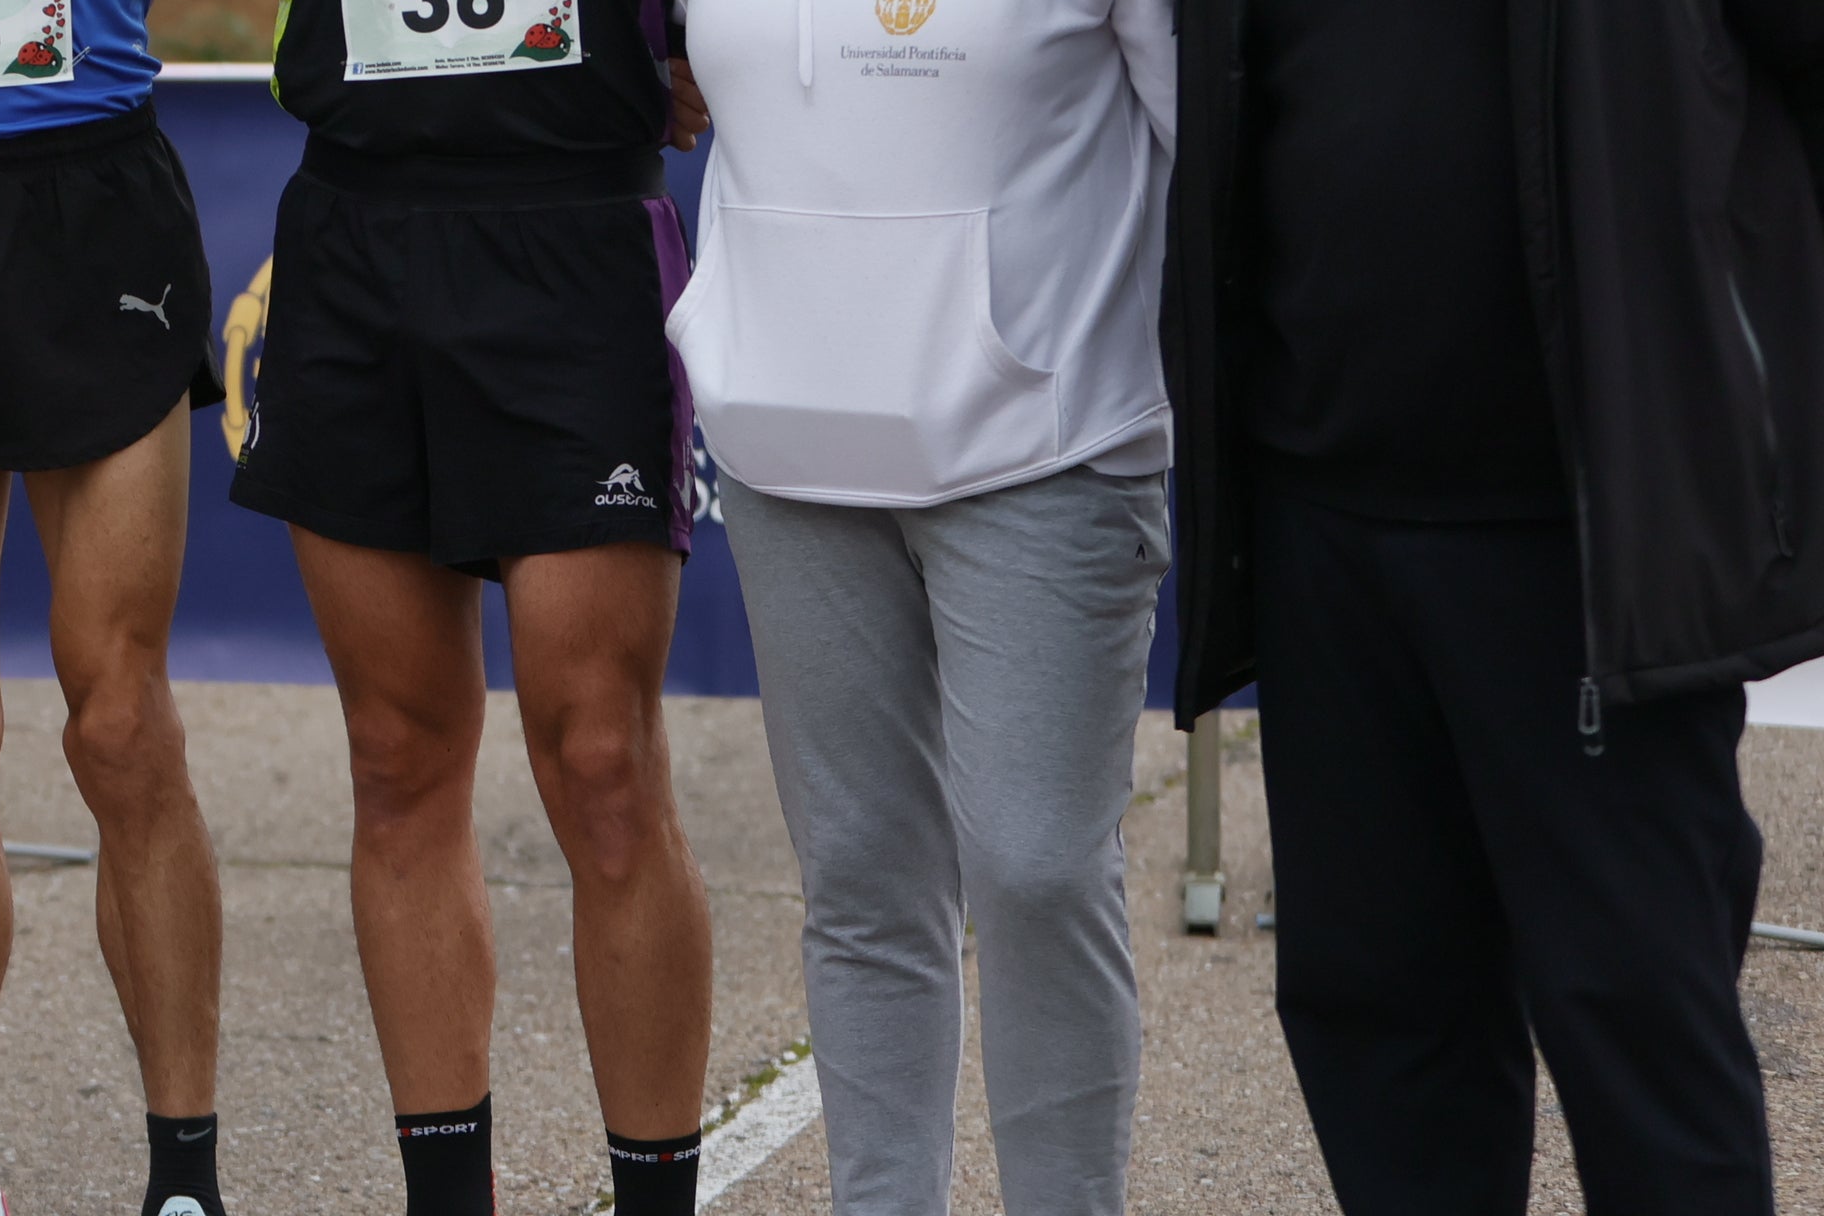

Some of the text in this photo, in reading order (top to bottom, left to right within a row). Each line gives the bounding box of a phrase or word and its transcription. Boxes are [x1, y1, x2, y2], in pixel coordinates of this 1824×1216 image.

[840, 45, 966, 62] Universidad Pontificia
[860, 63, 940, 78] de Salamanca
[594, 493, 658, 509] austral
